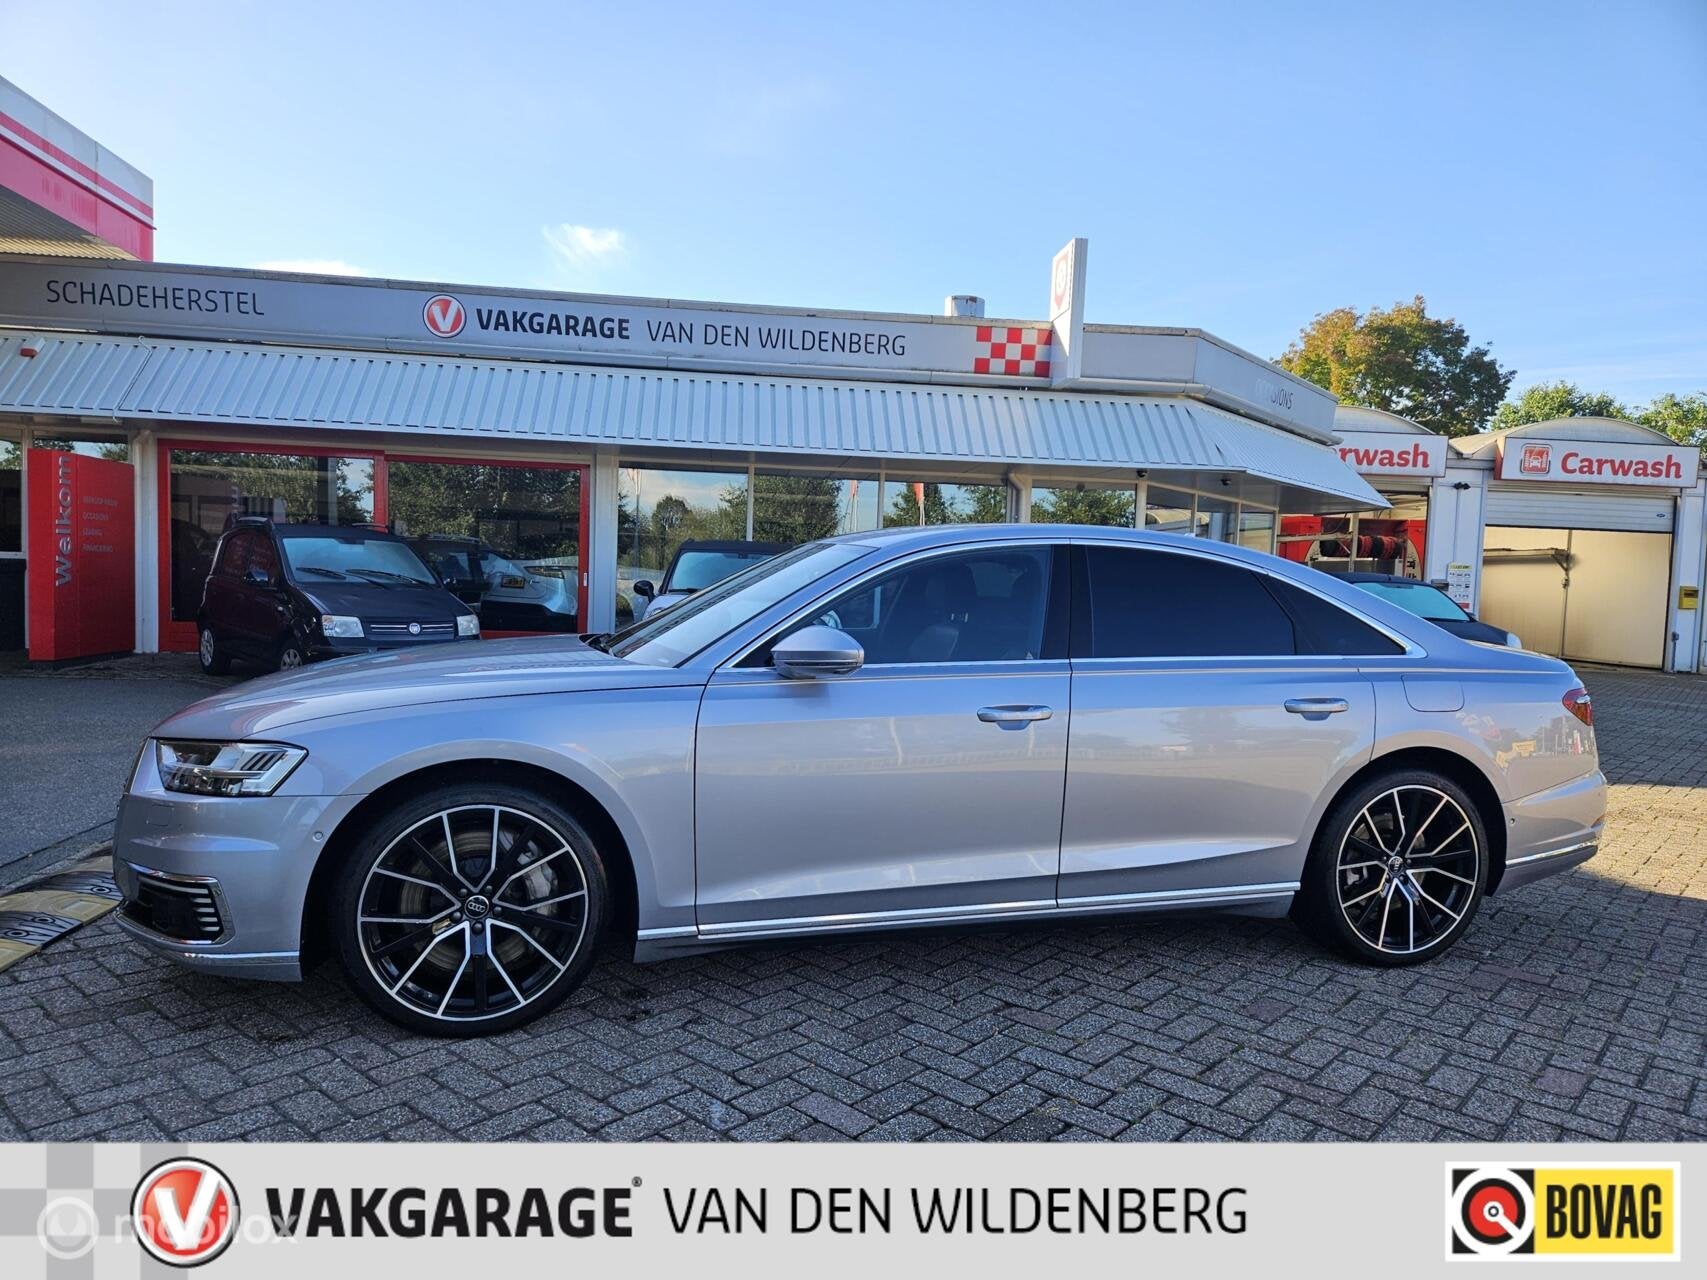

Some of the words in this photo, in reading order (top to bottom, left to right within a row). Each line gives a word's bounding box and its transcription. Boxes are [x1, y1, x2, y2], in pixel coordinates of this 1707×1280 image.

[46, 279, 265, 316] SCHADEHERSTEL
[475, 308, 631, 340] VAKGARAGE
[646, 319, 694, 344] VAN
[703, 323, 750, 348] DEN
[758, 326, 907, 356] WILDENBERG
[1338, 443, 1430, 469] rwash
[1560, 452, 1682, 479] Carwash
[55, 455, 73, 587] Welkom
